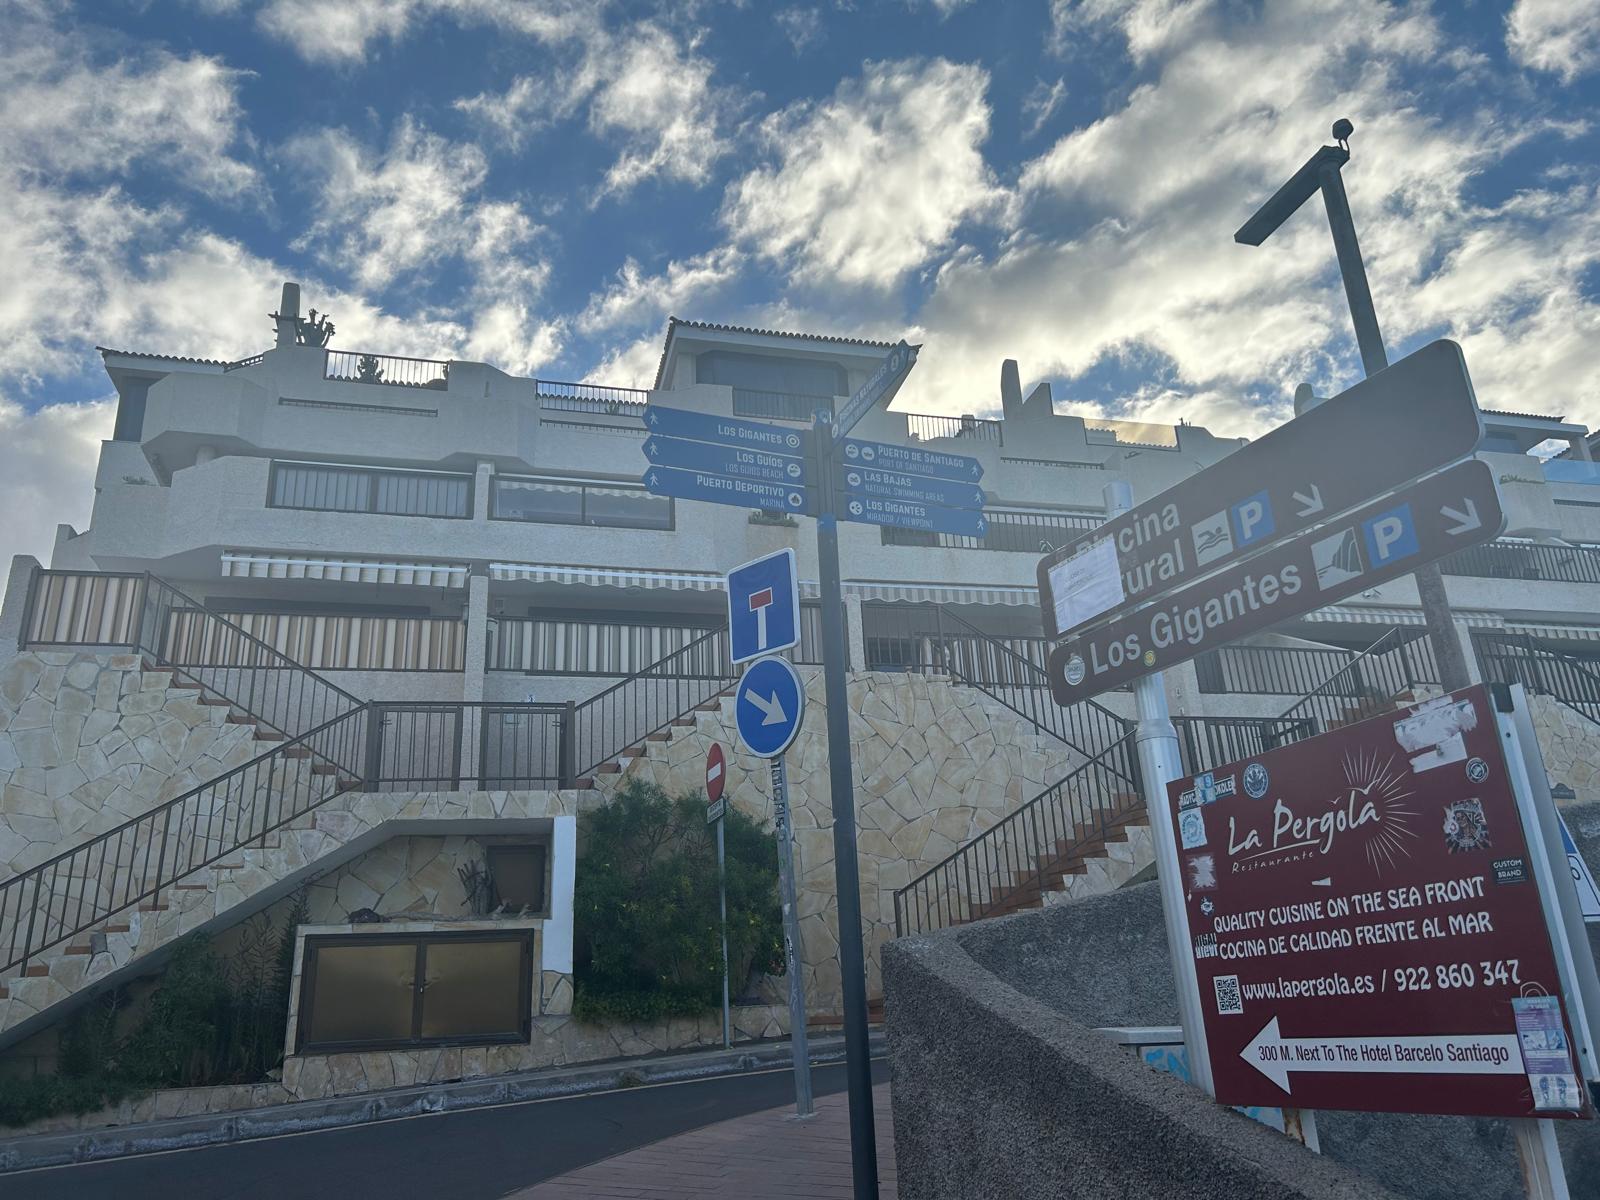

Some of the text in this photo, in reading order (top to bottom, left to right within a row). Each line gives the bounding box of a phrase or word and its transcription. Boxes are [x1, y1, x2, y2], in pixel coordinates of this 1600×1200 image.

[718, 424, 783, 444] LOS GIGANTES
[736, 451, 754, 463] LOS
[878, 445, 964, 468] PUERTO DE SANTIAGO
[725, 463, 738, 473] LOS
[864, 471, 912, 487] LAS BAJAS
[697, 475, 784, 497] PUERTO DEPORTIVO
[760, 498, 785, 509] MARINA
[866, 500, 926, 517] LOS GIGANTES
[1238, 500, 1263, 540] P
[1373, 516, 1403, 560] P
[1089, 633, 1141, 675] Los
[1150, 565, 1302, 645] Gigantes
[1228, 816, 1263, 856] La
[1273, 790, 1381, 854] Pergola
[1231, 851, 1313, 874] Restaurante
[1493, 859, 1522, 869] CUSTOM
[1498, 869, 1522, 878] BRAND
[1214, 876, 1484, 933] QUALITY CUISINE ON THE SEA FRONT
[1220, 939, 1267, 960] COCINA
[1269, 936, 1287, 954] DE
[1290, 928, 1352, 952] CALIDAD
[1355, 920, 1419, 945] FRENTE
[1422, 917, 1446, 938] AL
[1448, 911, 1493, 936] MAR
[1242, 959, 1520, 1000] www.lapergola.es / 922 860 347
[1258, 1045, 1278, 1061] 300
[1279, 1045, 1293, 1061] M.
[1295, 1045, 1320, 1061] Next
[1320, 1045, 1335, 1061] To
[1336, 1045, 1358, 1061] The
[1360, 1044, 1392, 1061] Hotel
[1394, 1043, 1443, 1062] Barcelo
[1447, 1043, 1509, 1065] Santiago
